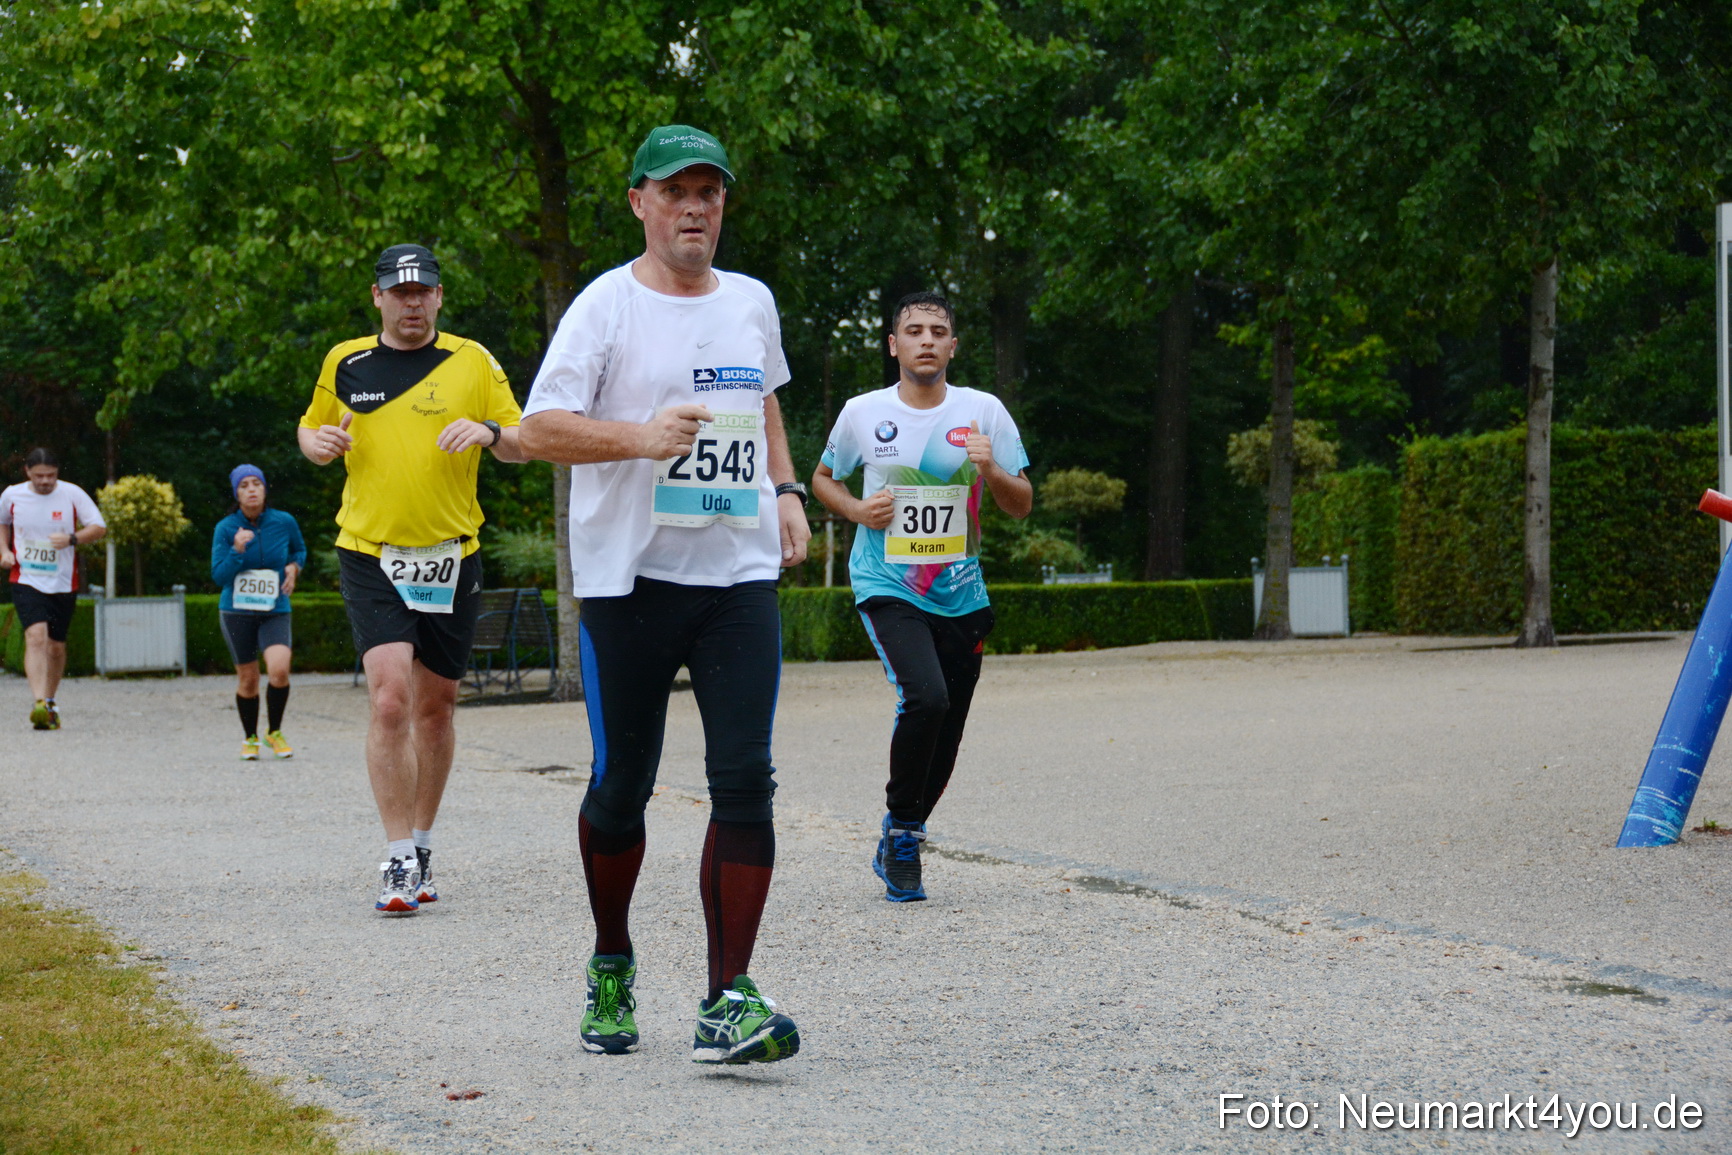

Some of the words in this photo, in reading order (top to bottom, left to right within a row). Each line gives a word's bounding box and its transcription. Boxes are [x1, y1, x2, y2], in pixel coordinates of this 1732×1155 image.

[694, 384, 711, 393] DAS
[350, 391, 386, 404] Robert
[411, 404, 448, 417] Burgthann
[713, 413, 757, 429] BOCK
[668, 439, 755, 483] 2543
[922, 488, 960, 499] BOCK
[702, 494, 731, 511] Udo
[903, 505, 954, 534] 307
[24, 547, 56, 562] 2703
[910, 542, 945, 553] Karam
[239, 578, 275, 595] 2505
